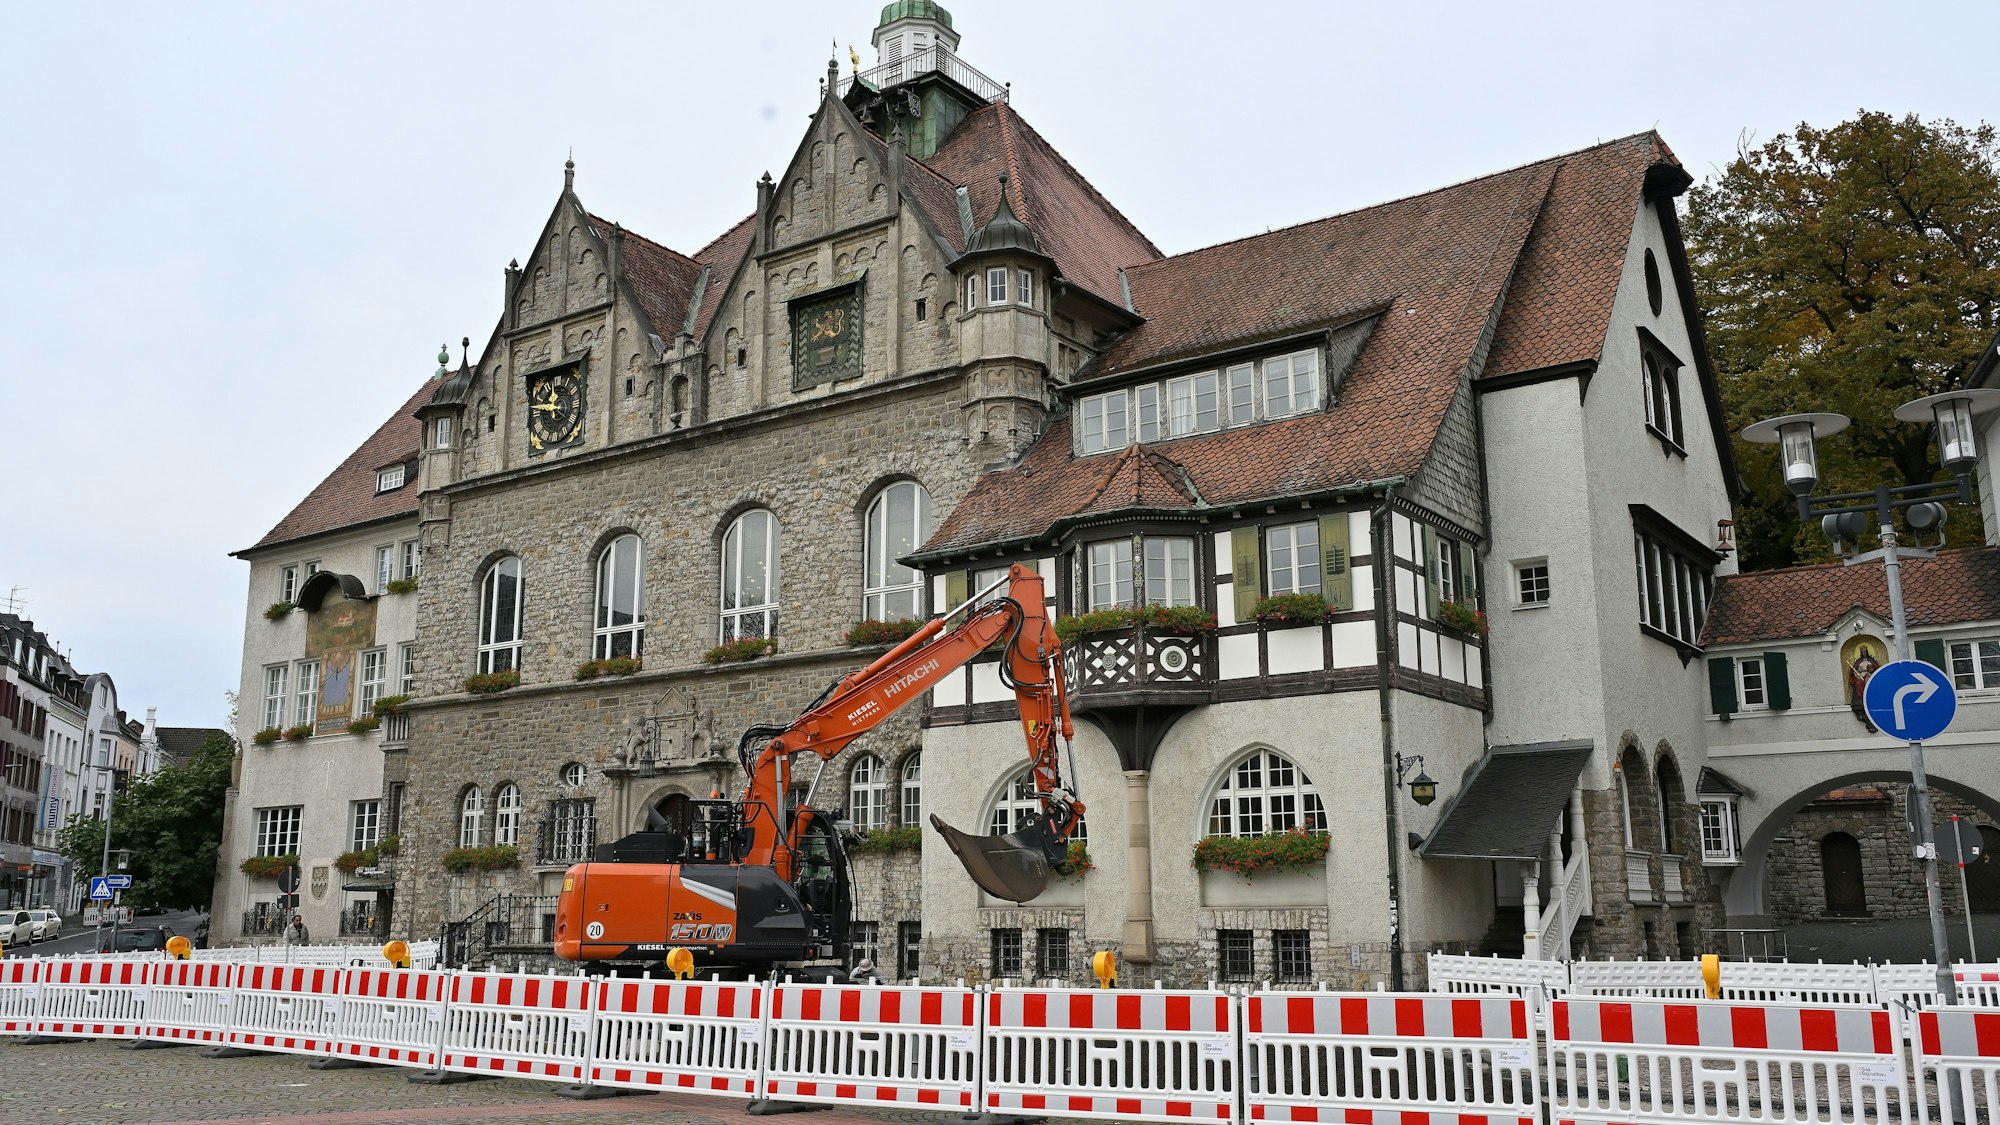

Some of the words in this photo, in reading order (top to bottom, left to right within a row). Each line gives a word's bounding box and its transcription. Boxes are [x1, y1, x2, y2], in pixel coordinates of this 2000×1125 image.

[883, 658, 940, 699] HITACHI
[847, 700, 878, 721] KIESEL
[851, 706, 881, 727] MIETPARK
[47, 797, 60, 828] munny
[673, 911, 703, 921] ZAXIS
[590, 925, 601, 936] 20
[670, 923, 733, 941] 150W
